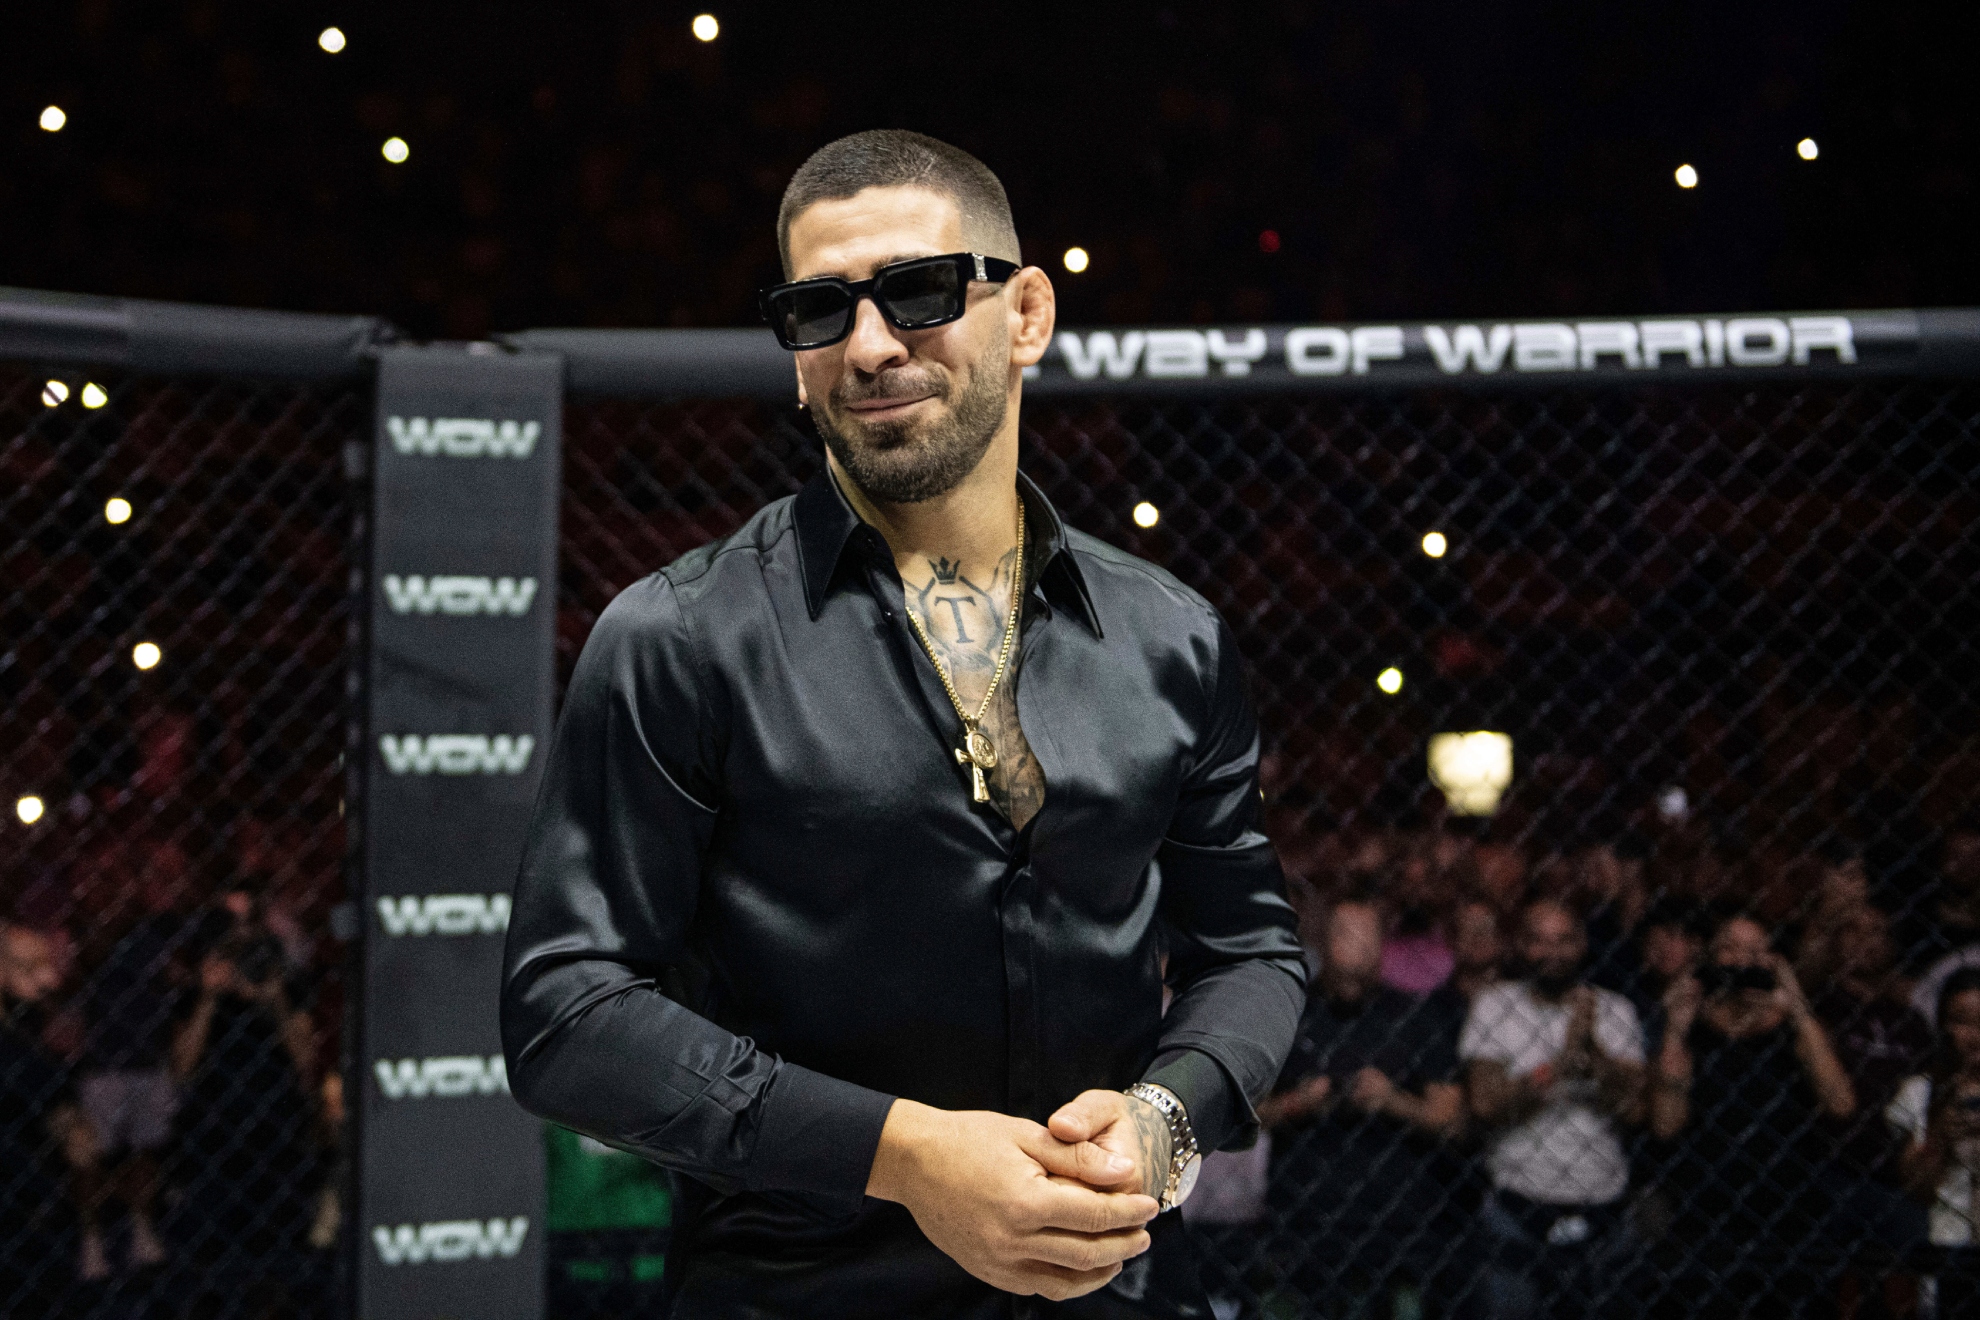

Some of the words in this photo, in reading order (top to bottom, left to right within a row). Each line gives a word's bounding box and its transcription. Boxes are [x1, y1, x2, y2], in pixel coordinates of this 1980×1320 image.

[1284, 325, 1405, 377] OF
[387, 415, 541, 458] WOW
[382, 574, 538, 615] WOW
[934, 595, 977, 644] T
[379, 733, 536, 776] WOW
[371, 1215, 530, 1265] WOW
